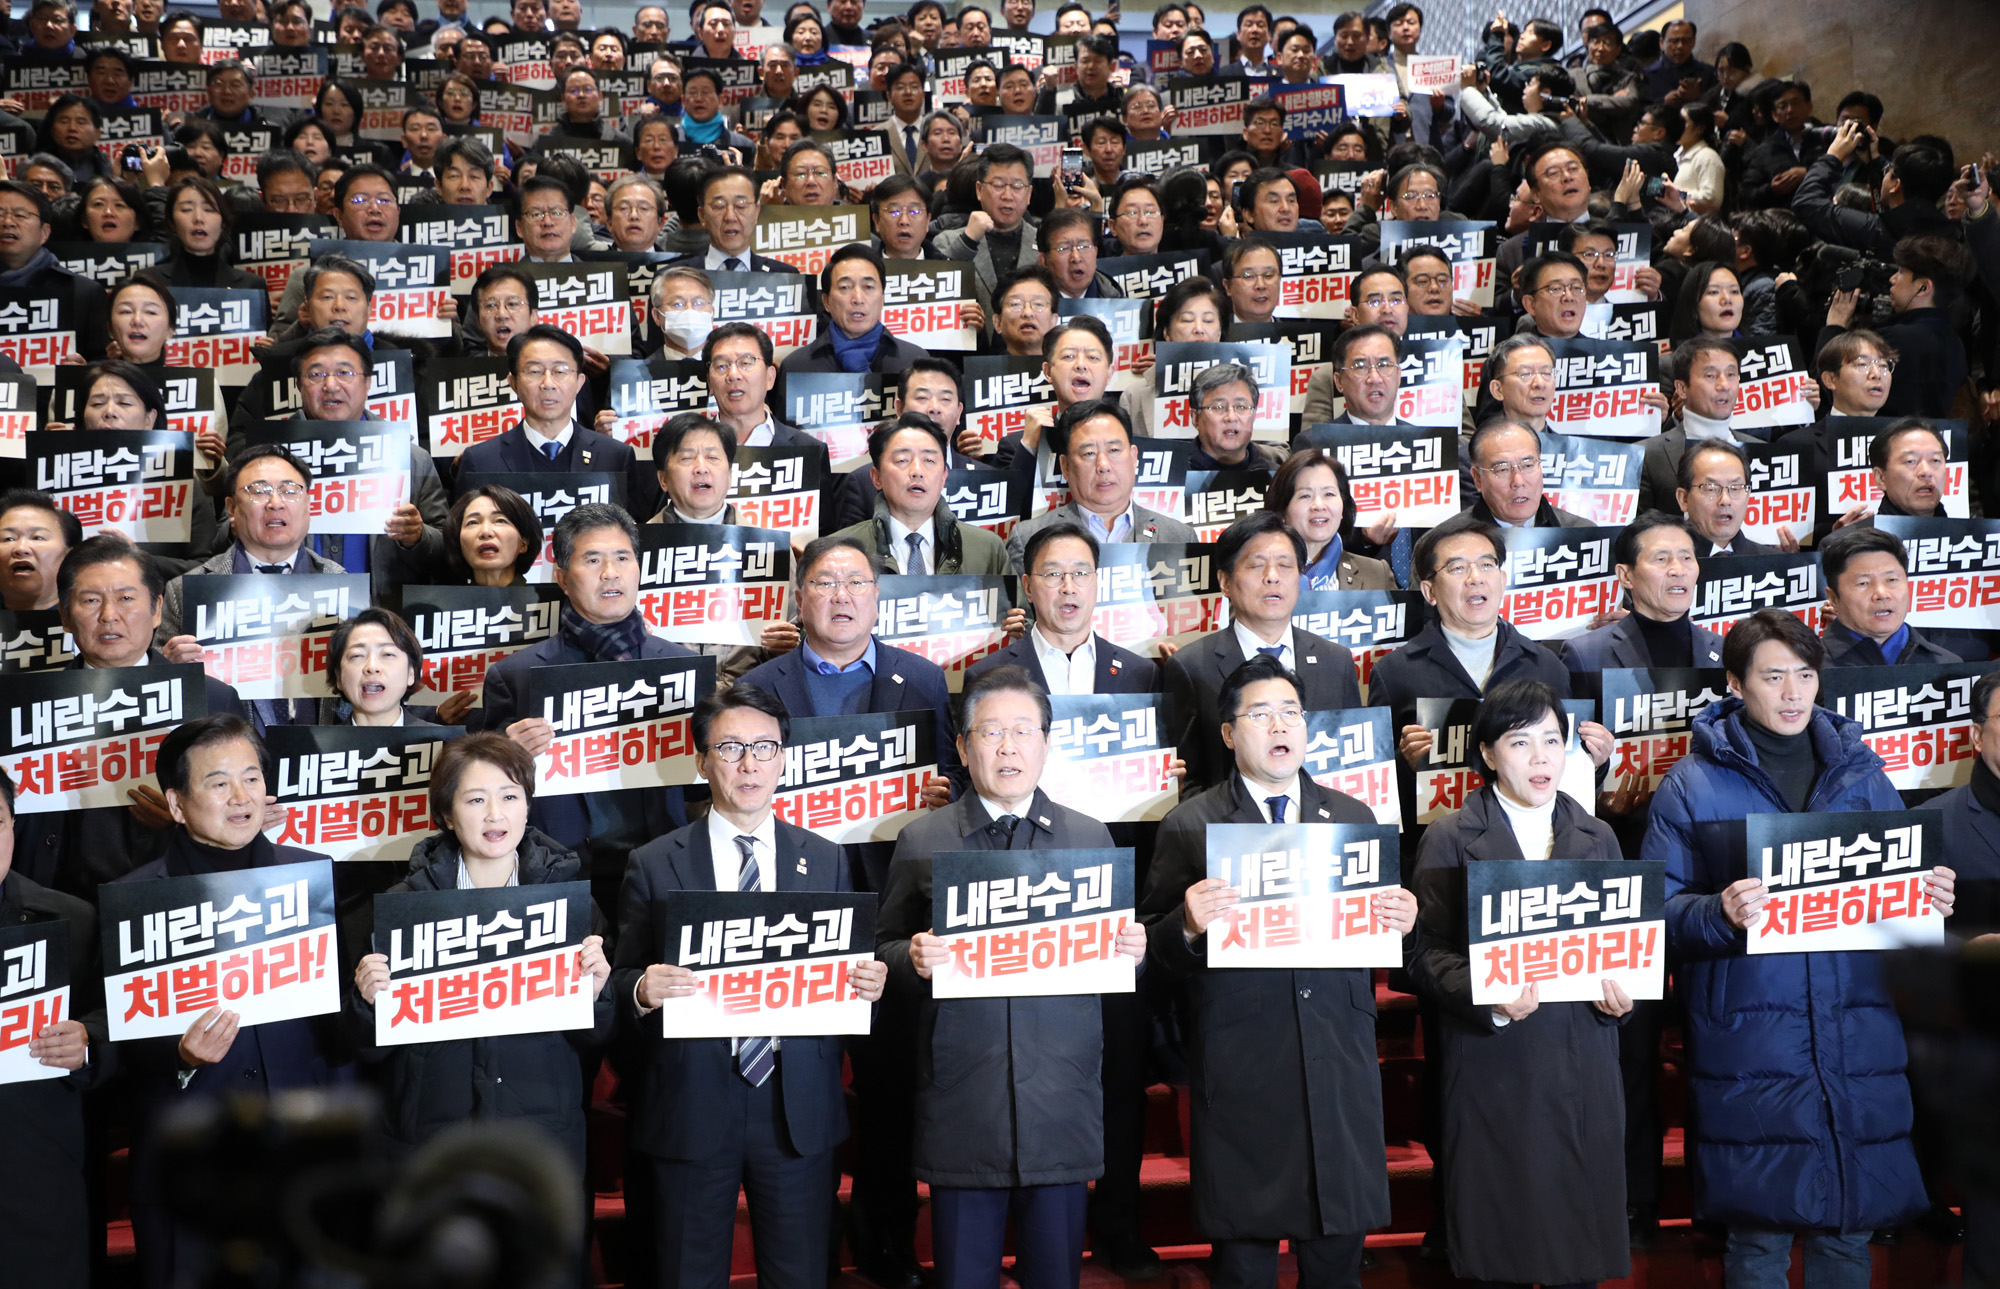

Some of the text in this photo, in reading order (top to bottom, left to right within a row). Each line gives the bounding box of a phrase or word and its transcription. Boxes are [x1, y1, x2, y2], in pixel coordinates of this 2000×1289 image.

[497, 40, 550, 64] 내란수
[10, 65, 89, 89] 내란수괴
[132, 69, 207, 93] 내란수괴
[1176, 80, 1242, 109] 내란수괴
[480, 90, 533, 113] 란수괴
[1176, 101, 1247, 129] 처벌하라
[1276, 87, 1337, 112] 내란행위
[827, 135, 882, 158] 란수괴
[987, 121, 1059, 145] 내란수괴
[835, 156, 890, 181] 벌하라!
[1127, 144, 1200, 171] 내란수괴
[402, 215, 510, 246] 내란수괴
[756, 213, 856, 250] 내란수괴
[1280, 243, 1350, 275] 란수괴
[369, 291, 446, 321] 하라!
[537, 271, 614, 308] 란수괴
[714, 284, 802, 319] 란수괴
[884, 270, 962, 304] 란수괴
[0, 298, 59, 332] 수괴
[1398, 351, 1447, 385] 수괴
[1740, 343, 1792, 379] 수괴
[439, 373, 520, 411] 내란수
[621, 375, 708, 414] 내란수
[974, 372, 1056, 408] 내란수
[1398, 384, 1456, 420] 하라!
[440, 406, 525, 446] 처벌하
[37, 443, 175, 490] 내란수괴
[281, 434, 391, 475] 란수괴
[1540, 454, 1628, 486] 란수괴
[1750, 454, 1799, 490] 수괴
[307, 474, 405, 517] 벌하라!
[736, 495, 814, 530] 하라!
[946, 481, 1007, 519] 수괴
[1181, 486, 1265, 525] 내란수
[1352, 475, 1454, 513] 벌하라!
[1744, 492, 1810, 525] 하라!
[641, 541, 775, 586] 내란수괴
[1505, 538, 1610, 586] 란수괴
[639, 585, 784, 628] 처벌하라!
[1691, 563, 1817, 616] 내란수괴
[196, 586, 349, 641] 내란수괴
[415, 601, 560, 650] 내란수괴
[1292, 602, 1407, 645] 란수괴
[11, 677, 183, 748] 내란수괴
[543, 669, 696, 732] 내란수괴
[1615, 688, 1724, 733] 내란수
[544, 712, 694, 782] 처벌하라
[1049, 706, 1157, 756] 란수괴
[1305, 721, 1374, 770] 수괴
[14, 731, 169, 796] 처벌하
[277, 741, 443, 797] 내란수괴
[779, 724, 917, 787] 내란수괴
[1087, 753, 1172, 795] 하라!
[276, 793, 438, 845] 처벌하라
[1760, 824, 1922, 888] 내란수괴
[946, 863, 1113, 929] 내란수괴
[1481, 875, 1642, 936] 내란수괴
[119, 879, 309, 967] 내란수괴
[390, 898, 567, 972] 내란수괴
[678, 907, 854, 967] 내란수괴
[1484, 927, 1657, 989] 처벌하라!
[123, 932, 328, 1024] 처벌하라!
[390, 951, 581, 1028] 처벌하라!
[699, 960, 858, 1016] 벌하라
